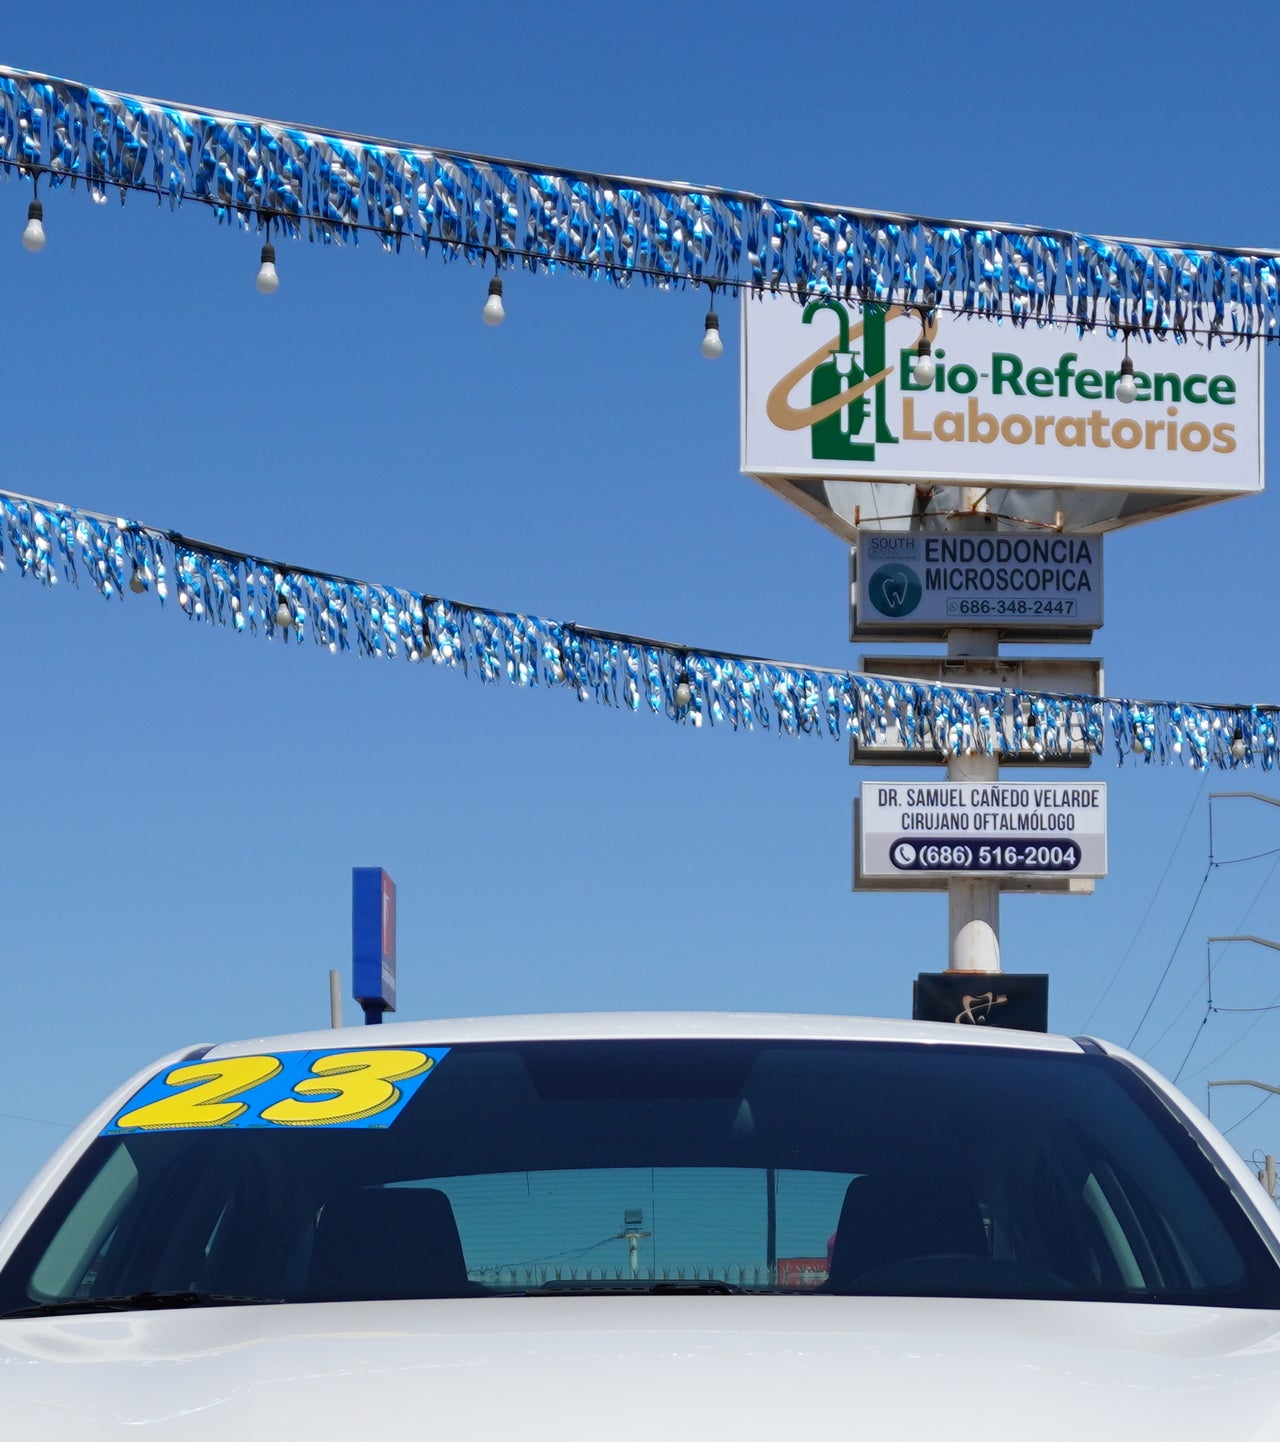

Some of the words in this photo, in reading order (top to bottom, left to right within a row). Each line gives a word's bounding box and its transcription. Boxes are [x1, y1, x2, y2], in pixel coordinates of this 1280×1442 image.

[902, 396, 1237, 454] Laboratorios
[871, 537, 915, 549] SOUTH
[925, 538, 1092, 563] ENDODONCIA
[925, 568, 1092, 591] MICROSCOPICA
[959, 600, 1074, 615] 686-348-2447
[878, 788, 902, 807] DR.
[907, 788, 967, 807] SAMUEL
[970, 785, 1030, 807] CAÑEDO
[1033, 789, 1100, 808] VELARDE
[901, 813, 969, 831] CIRUJANO
[973, 809, 1076, 831] OFTALMÓLOGO
[919, 845, 973, 867] (686)
[979, 846, 1077, 865] 516-2004
[117, 1049, 436, 1131] 23
